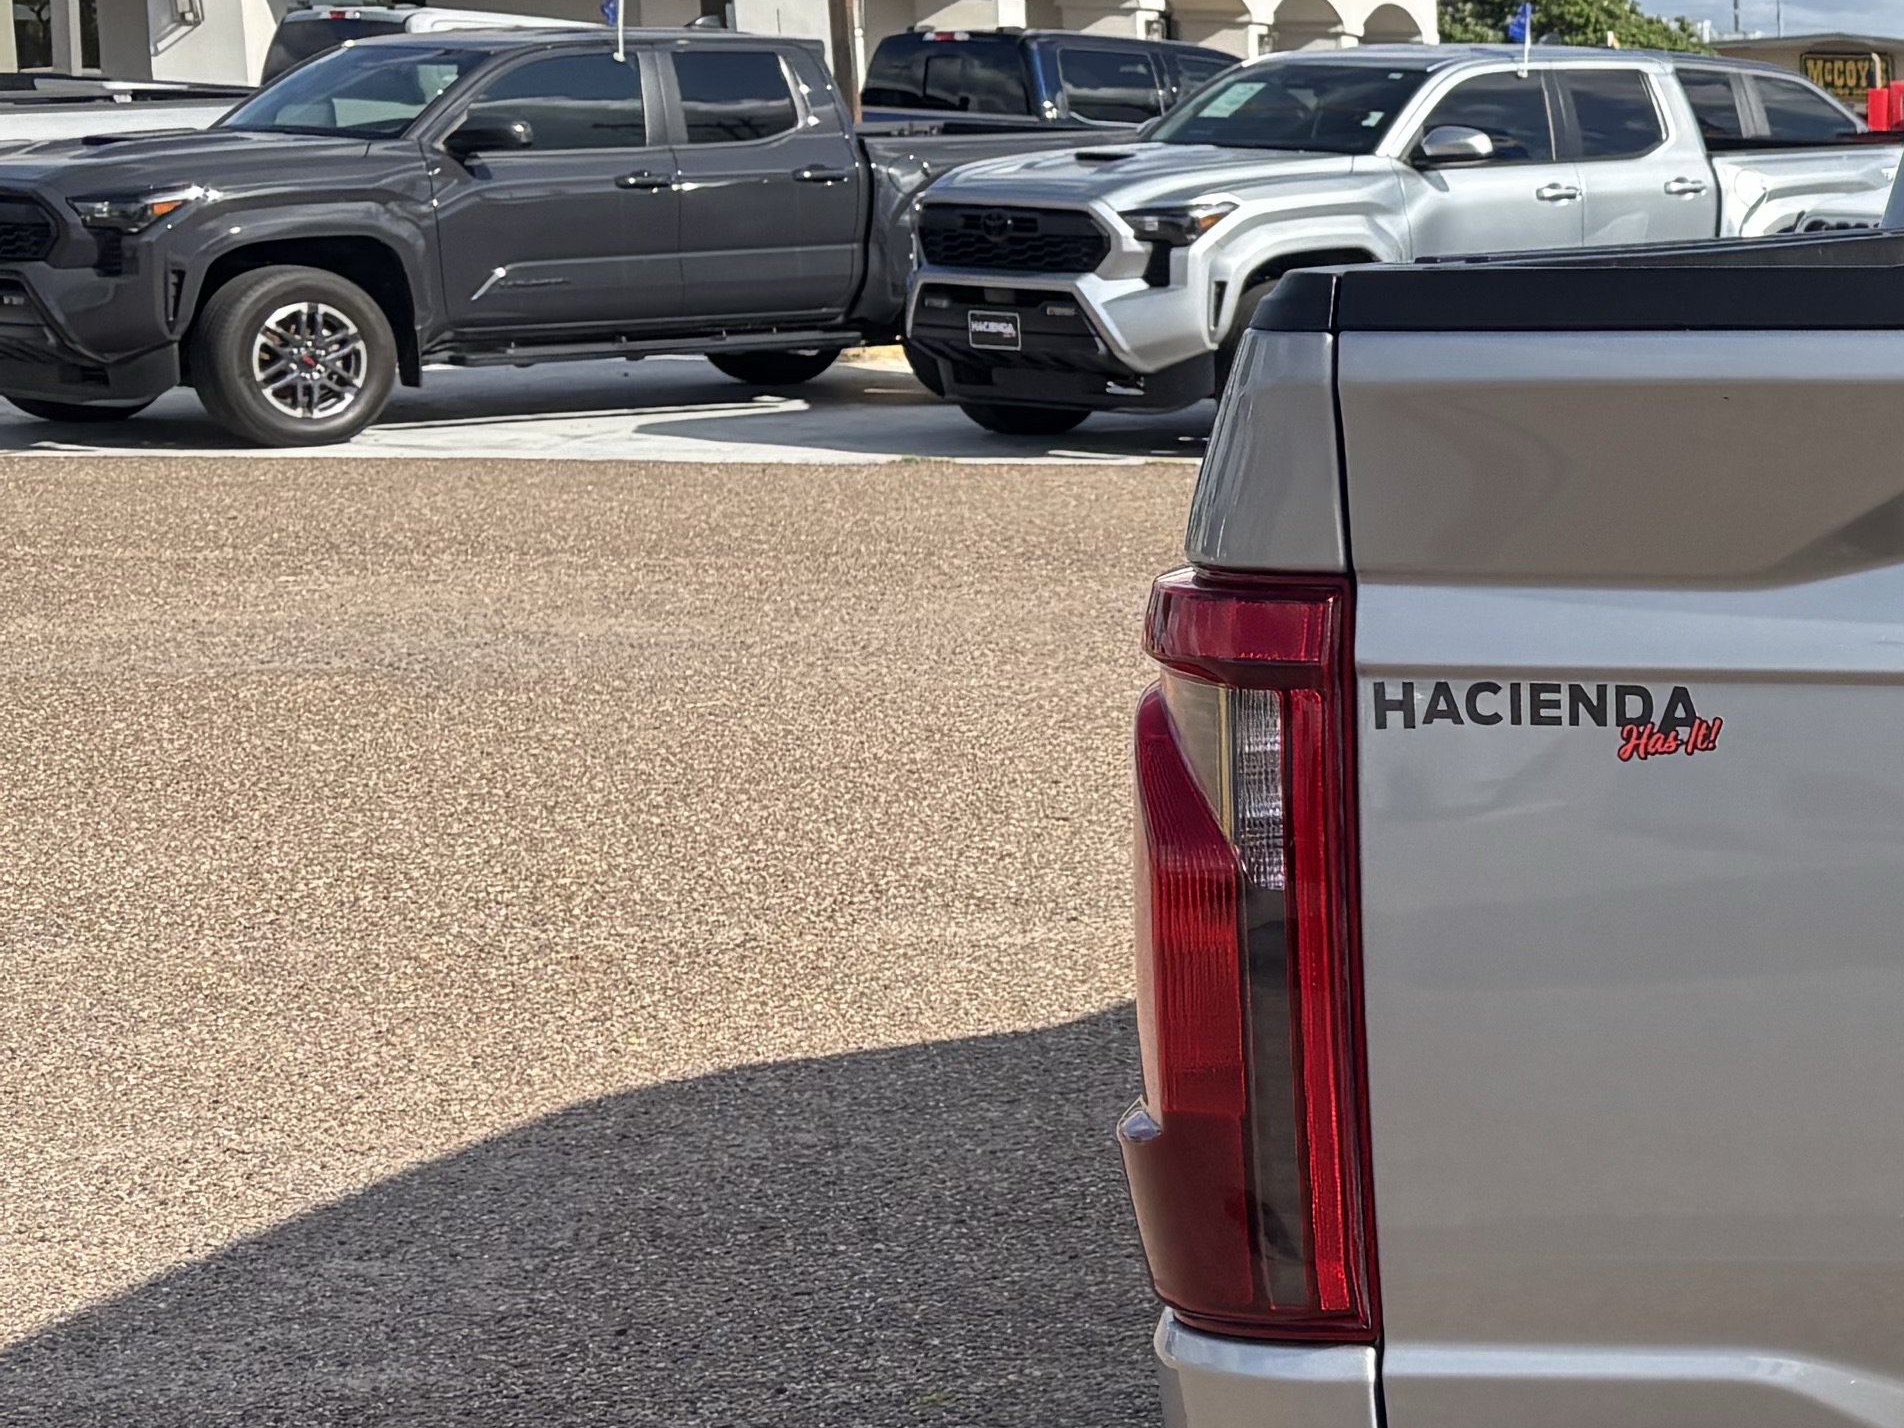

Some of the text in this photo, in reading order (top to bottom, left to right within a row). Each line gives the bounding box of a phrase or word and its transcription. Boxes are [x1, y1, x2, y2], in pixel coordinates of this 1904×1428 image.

[1373, 680, 1698, 730] HACIENDA
[1617, 716, 1723, 763] Has It!
